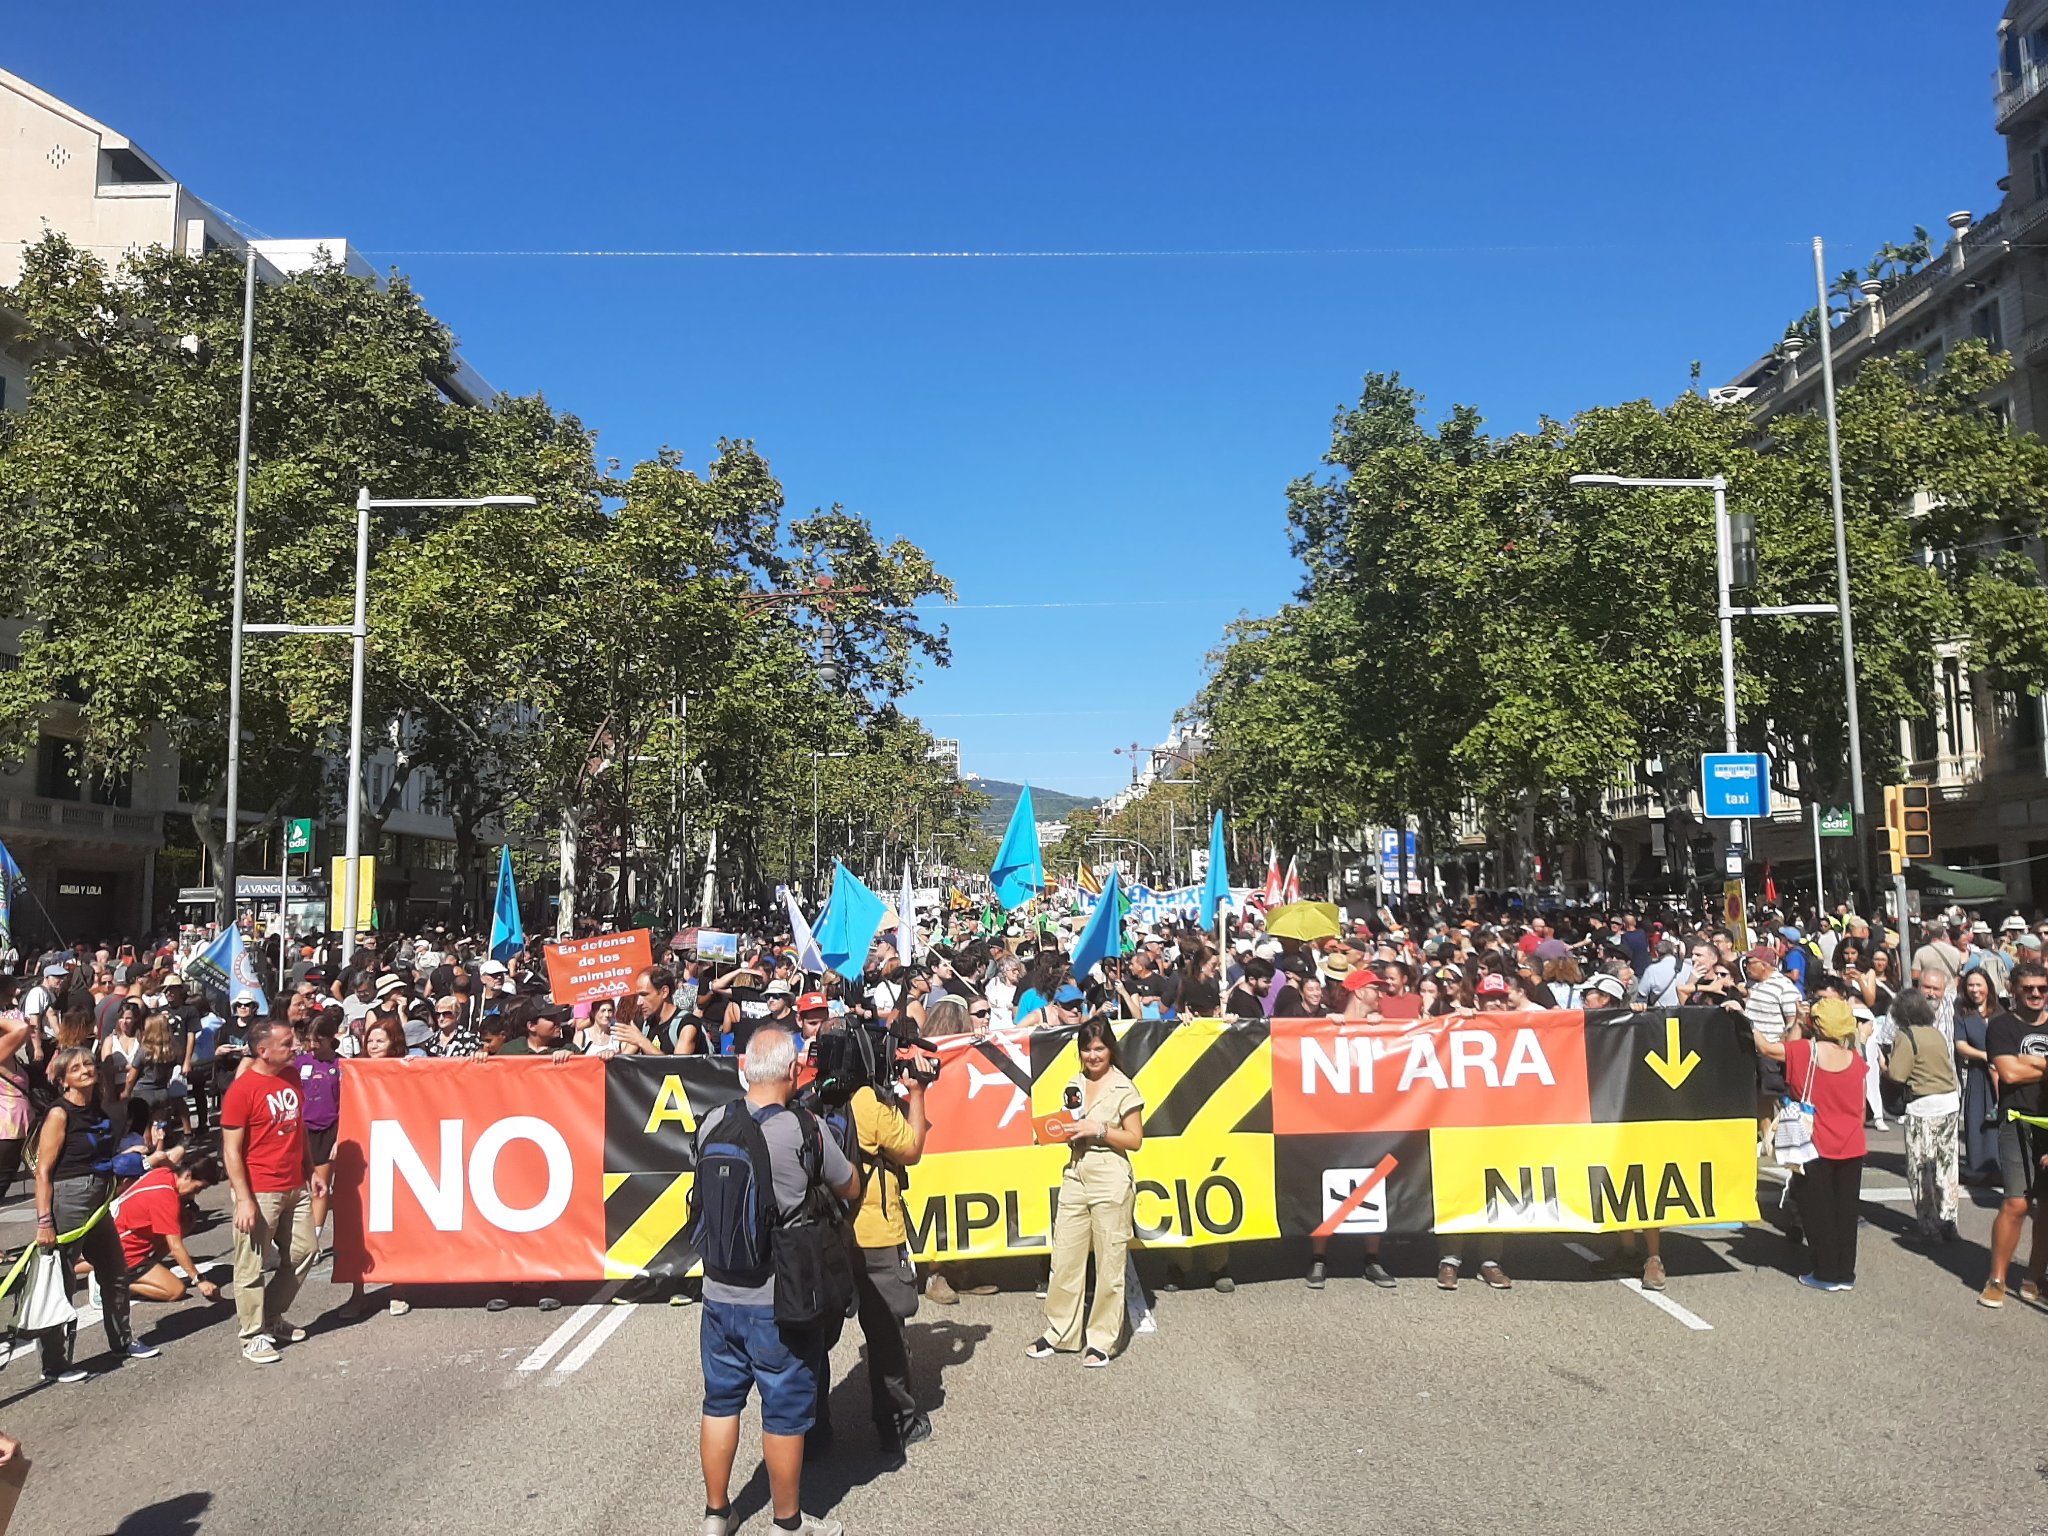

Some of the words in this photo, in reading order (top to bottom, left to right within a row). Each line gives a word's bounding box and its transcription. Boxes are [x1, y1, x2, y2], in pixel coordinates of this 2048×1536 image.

[1725, 791, 1750, 805] taxi
[1821, 820, 1849, 829] adif
[1384, 832, 1399, 853] P
[87, 885, 102, 895] LOLA
[238, 884, 251, 894] LA
[558, 944, 577, 956] En
[580, 934, 636, 952] defensa
[578, 956, 596, 967] de
[599, 952, 621, 964] los
[569, 966, 633, 985] animales
[1300, 1034, 1374, 1094] NI
[1396, 1027, 1556, 1092] ARA
[643, 1074, 698, 1133] A
[368, 1115, 574, 1233] NO
[1484, 1166, 1560, 1224] NI
[1587, 1162, 1716, 1223] MAI
